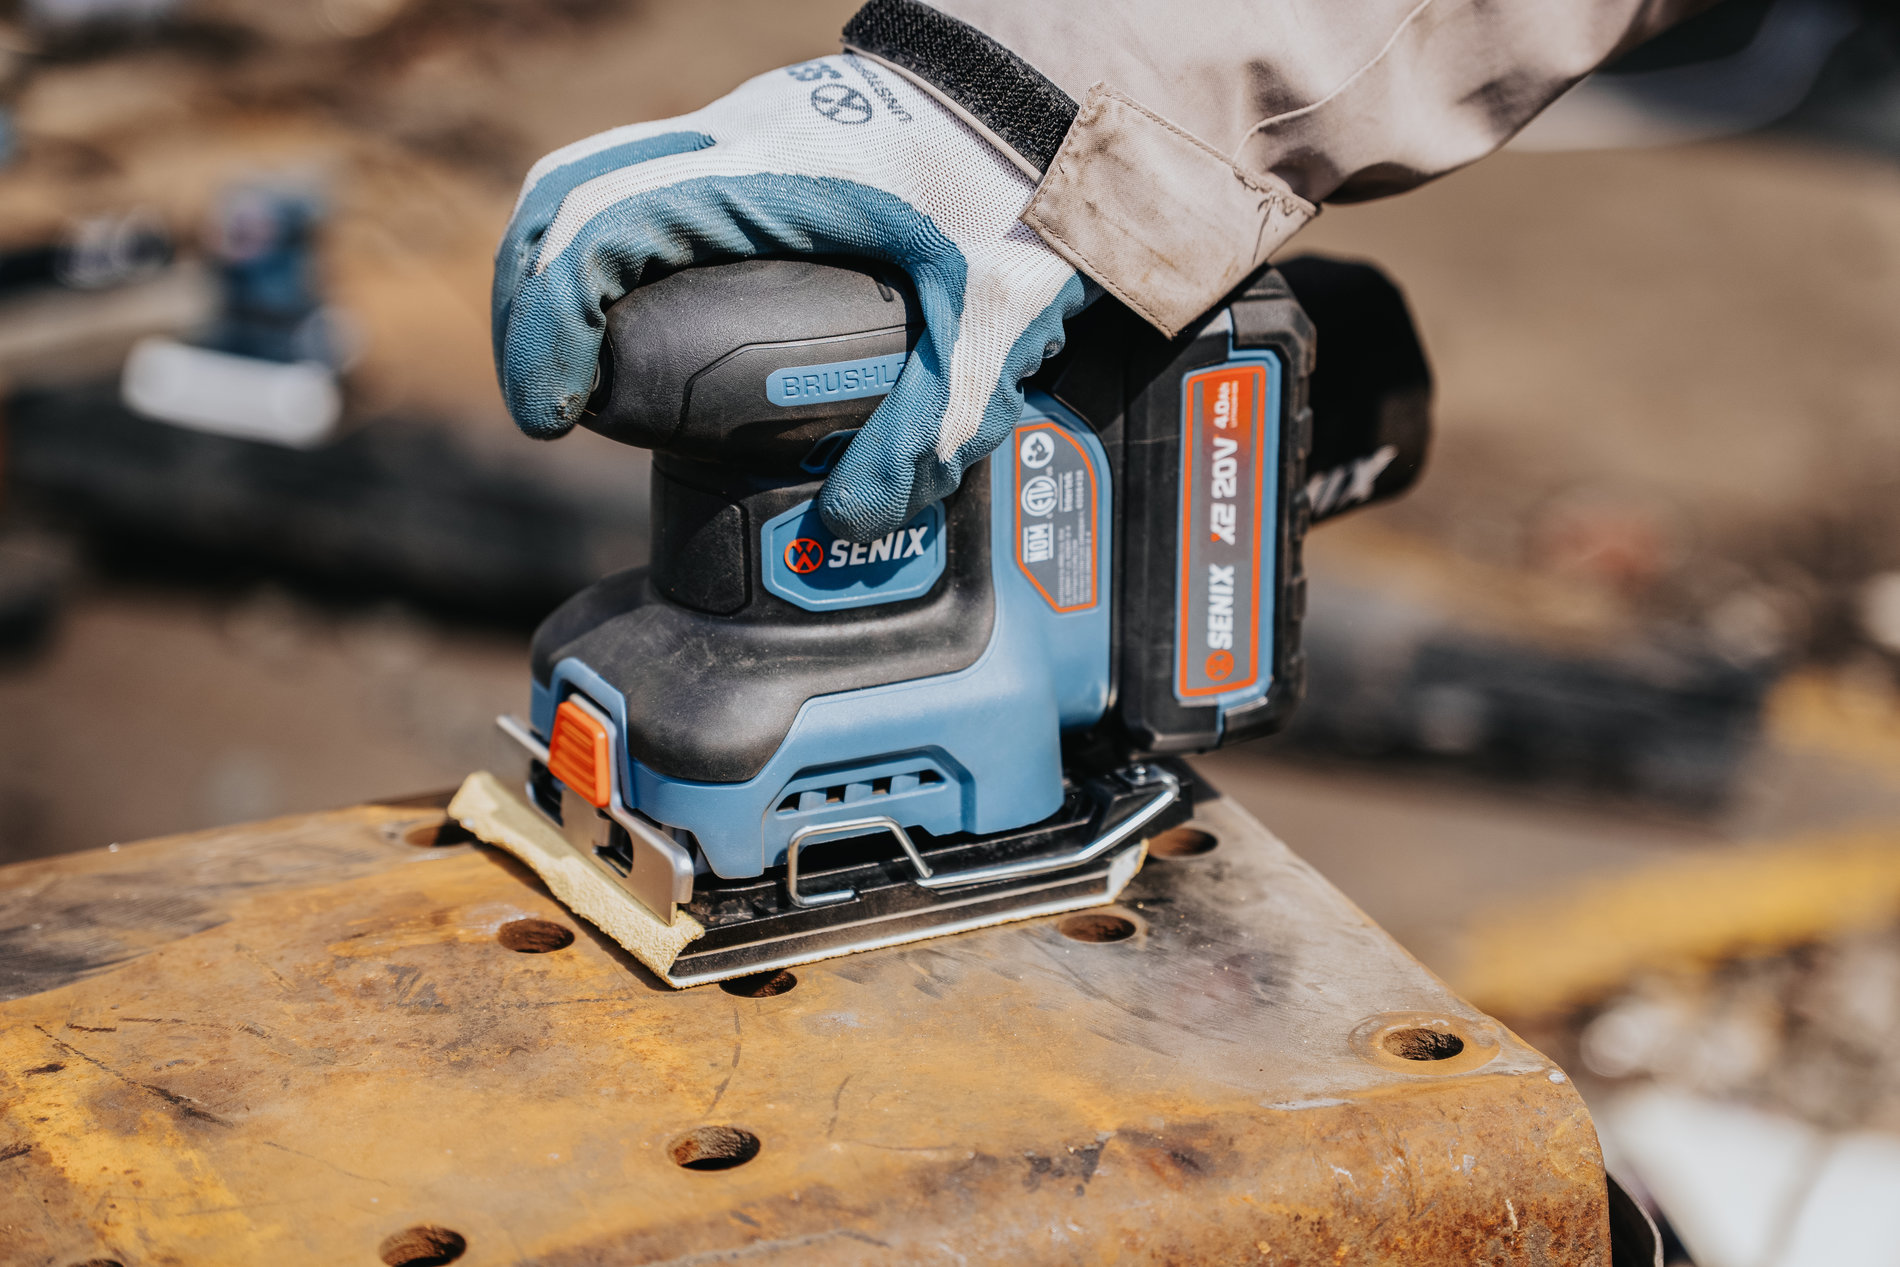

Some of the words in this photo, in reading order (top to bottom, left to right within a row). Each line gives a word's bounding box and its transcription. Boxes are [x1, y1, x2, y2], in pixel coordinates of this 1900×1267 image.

[828, 526, 929, 569] SENIX
[1028, 523, 1049, 563] NOM
[1207, 563, 1234, 650] SENIX
